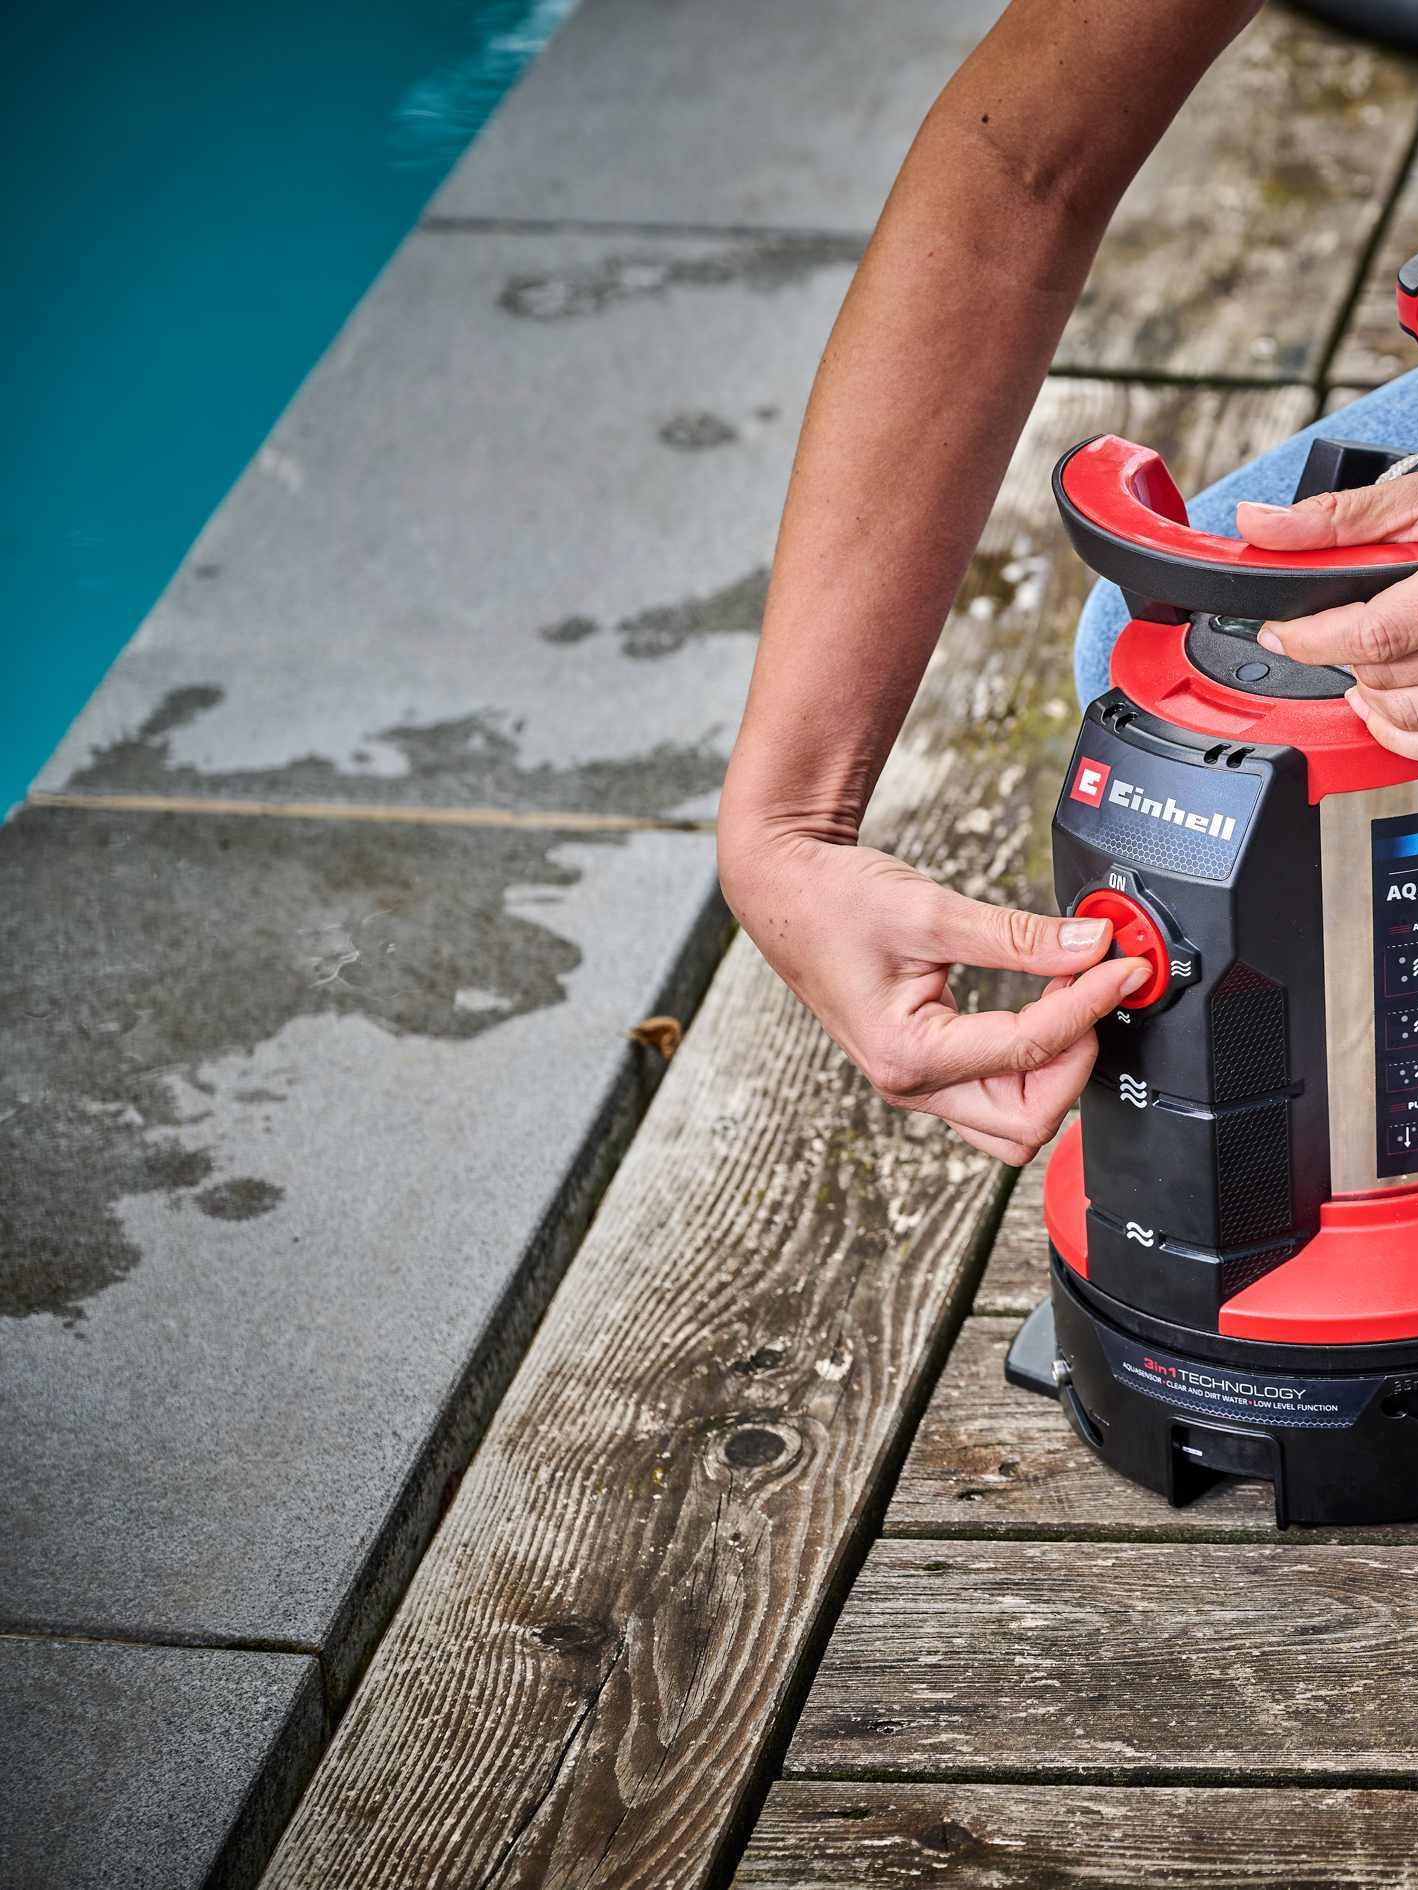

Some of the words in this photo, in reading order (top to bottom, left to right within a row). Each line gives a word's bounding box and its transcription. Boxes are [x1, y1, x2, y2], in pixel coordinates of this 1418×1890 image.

[1108, 779, 1237, 841] Einhell
[1109, 872, 1126, 891] ON
[1122, 1361, 1162, 1384] AQUASENSOR
[1166, 1380, 1186, 1392] CLEAR
[1188, 1386, 1203, 1397] AND
[1204, 1390, 1221, 1402] DIRT
[1222, 1394, 1248, 1406] WATER
[1253, 1399, 1271, 1408] LOW
[1273, 1402, 1295, 1410] LEVEL
[1297, 1403, 1338, 1412] FUNCTION
